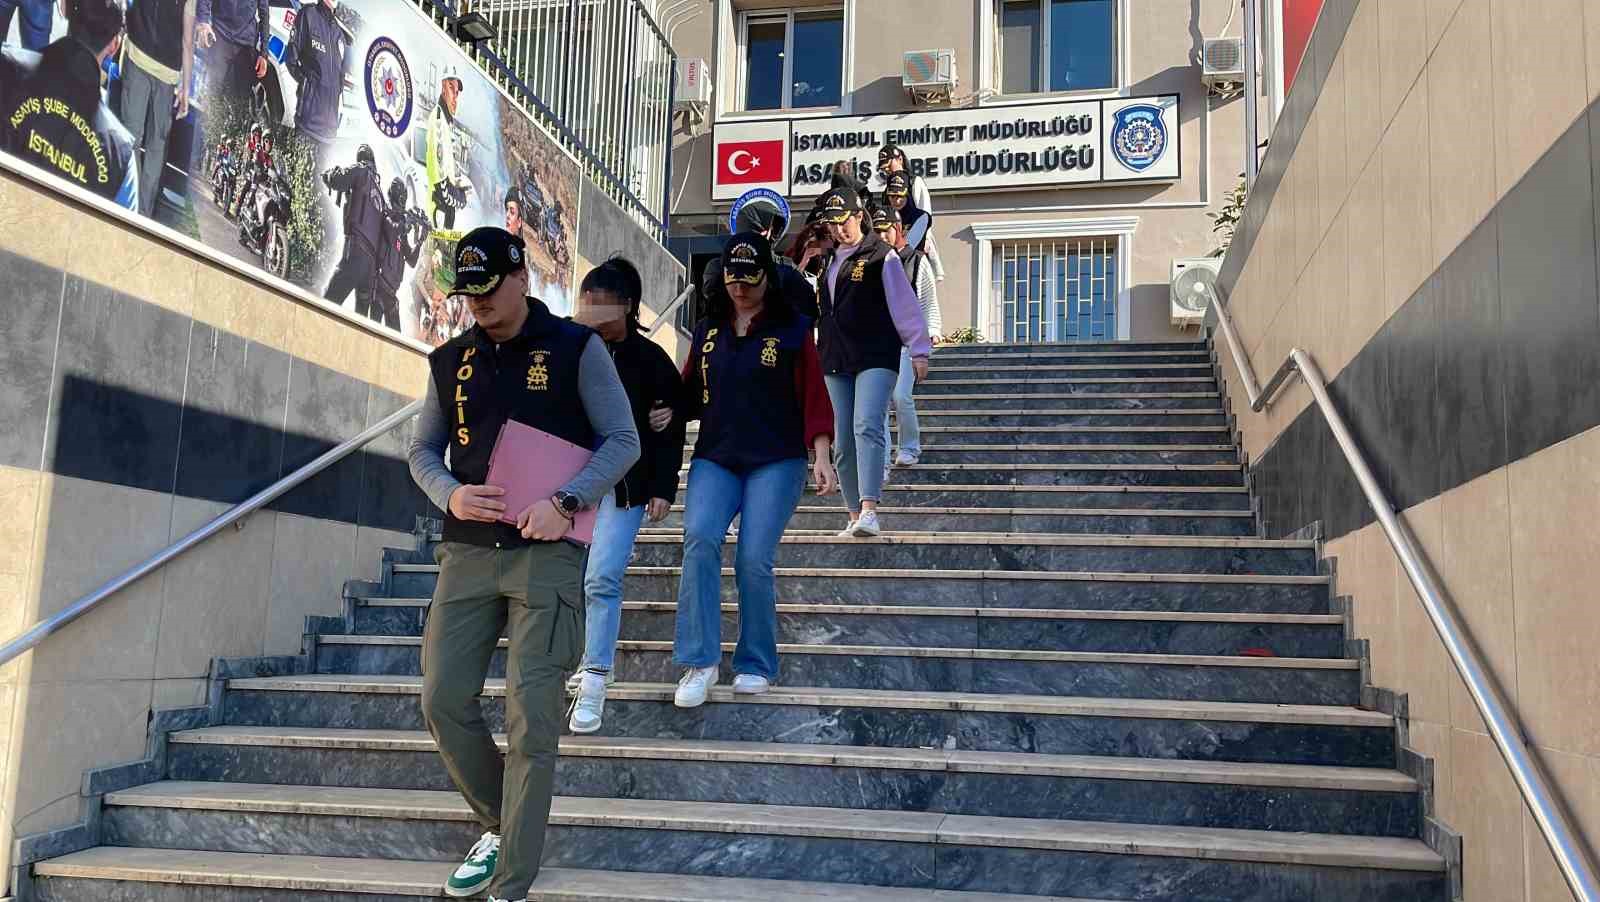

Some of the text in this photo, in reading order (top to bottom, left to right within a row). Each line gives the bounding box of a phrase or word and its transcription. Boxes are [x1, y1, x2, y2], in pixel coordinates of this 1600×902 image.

[43, 97, 70, 118] ŞUBE
[793, 114, 1093, 151] İSTANBUL EMNİYET MÜDÜRLÜĞÜ
[29, 129, 88, 183] İSTANBUL
[793, 156, 872, 185] ASAİŞ
[945, 144, 1095, 176] MÜDÜRLÜĞÜ
[455, 346, 476, 446] POLİS
